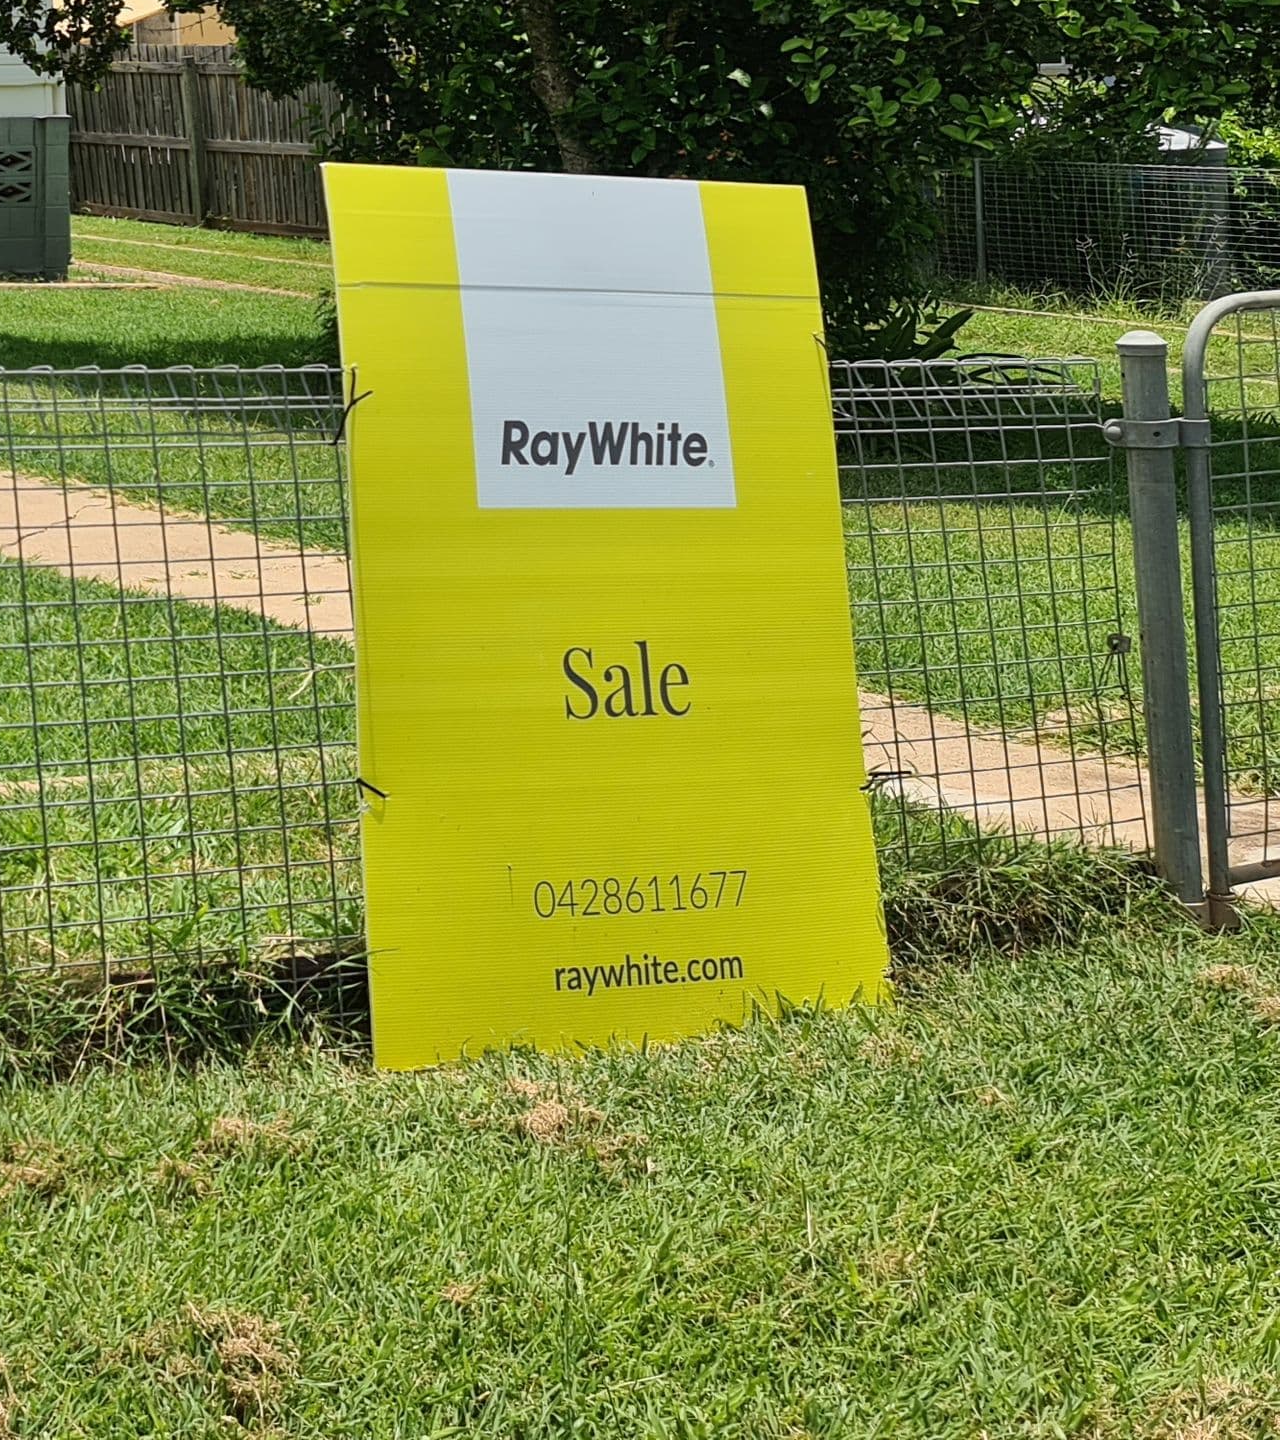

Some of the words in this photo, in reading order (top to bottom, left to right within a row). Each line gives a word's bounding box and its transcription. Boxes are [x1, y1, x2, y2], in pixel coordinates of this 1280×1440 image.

[562, 640, 691, 720] Sale
[534, 870, 747, 918] 0428611677
[554, 953, 744, 997] raywhite.com
